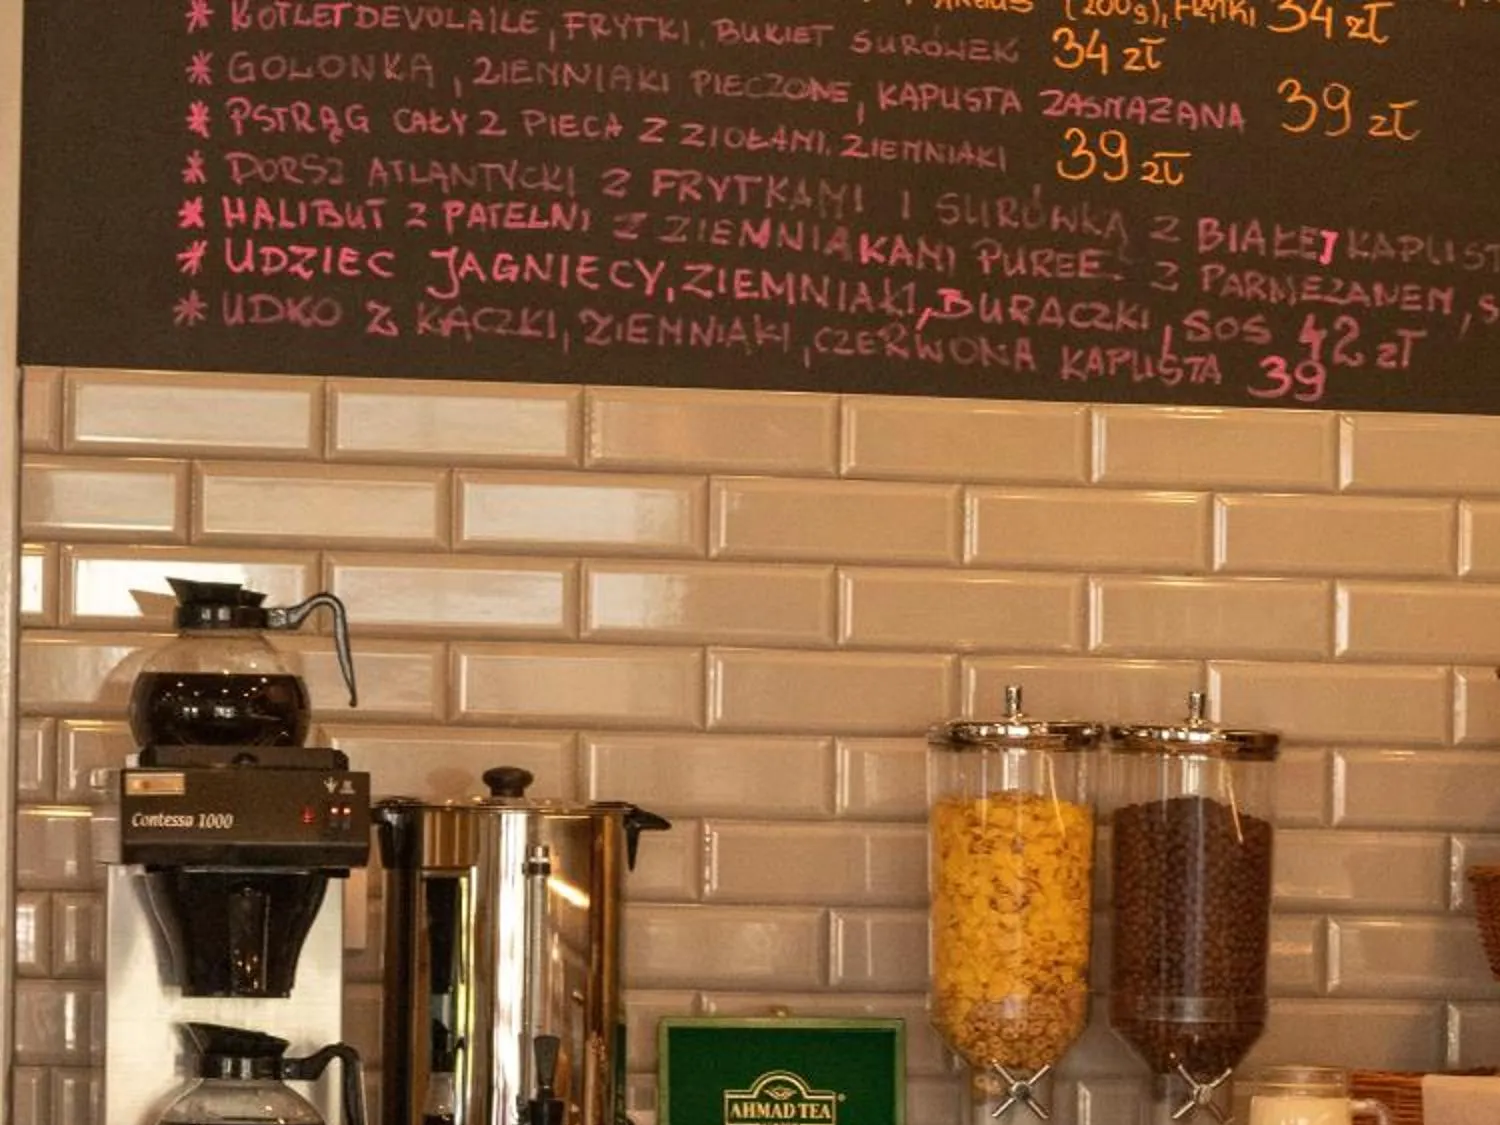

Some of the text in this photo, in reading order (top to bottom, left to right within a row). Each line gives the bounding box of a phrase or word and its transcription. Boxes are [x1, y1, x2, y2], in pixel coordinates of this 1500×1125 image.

[712, 18, 835, 47] BUKIET
[1052, 26, 1109, 75] 34
[876, 80, 1022, 115] KAPUSTA
[1276, 78, 1351, 137] 39
[225, 96, 370, 144] PSTRĄG
[393, 104, 468, 136] CAŁY
[520, 109, 624, 138] PIECA
[638, 116, 669, 143] Z
[1056, 127, 1130, 182] 39
[220, 195, 387, 231] HALIBUT
[440, 200, 592, 235] PATELNI
[224, 151, 345, 186] DORSZ
[367, 158, 577, 199] ATLANTYCKI
[651, 169, 864, 221] FRYTKAMI
[224, 237, 396, 280] UDZIEC
[1182, 309, 1272, 344] SOS
[1300, 313, 1366, 367] 42
[222, 291, 343, 328] UDKO
[364, 301, 399, 336] Z
[814, 321, 1037, 373] CZERWONA
[1059, 344, 1223, 386] KAPUSTA
[1247, 355, 1327, 402] 39
[131, 812, 235, 829] Contessa 1000
[729, 1101, 832, 1119] AHMAD TEA
